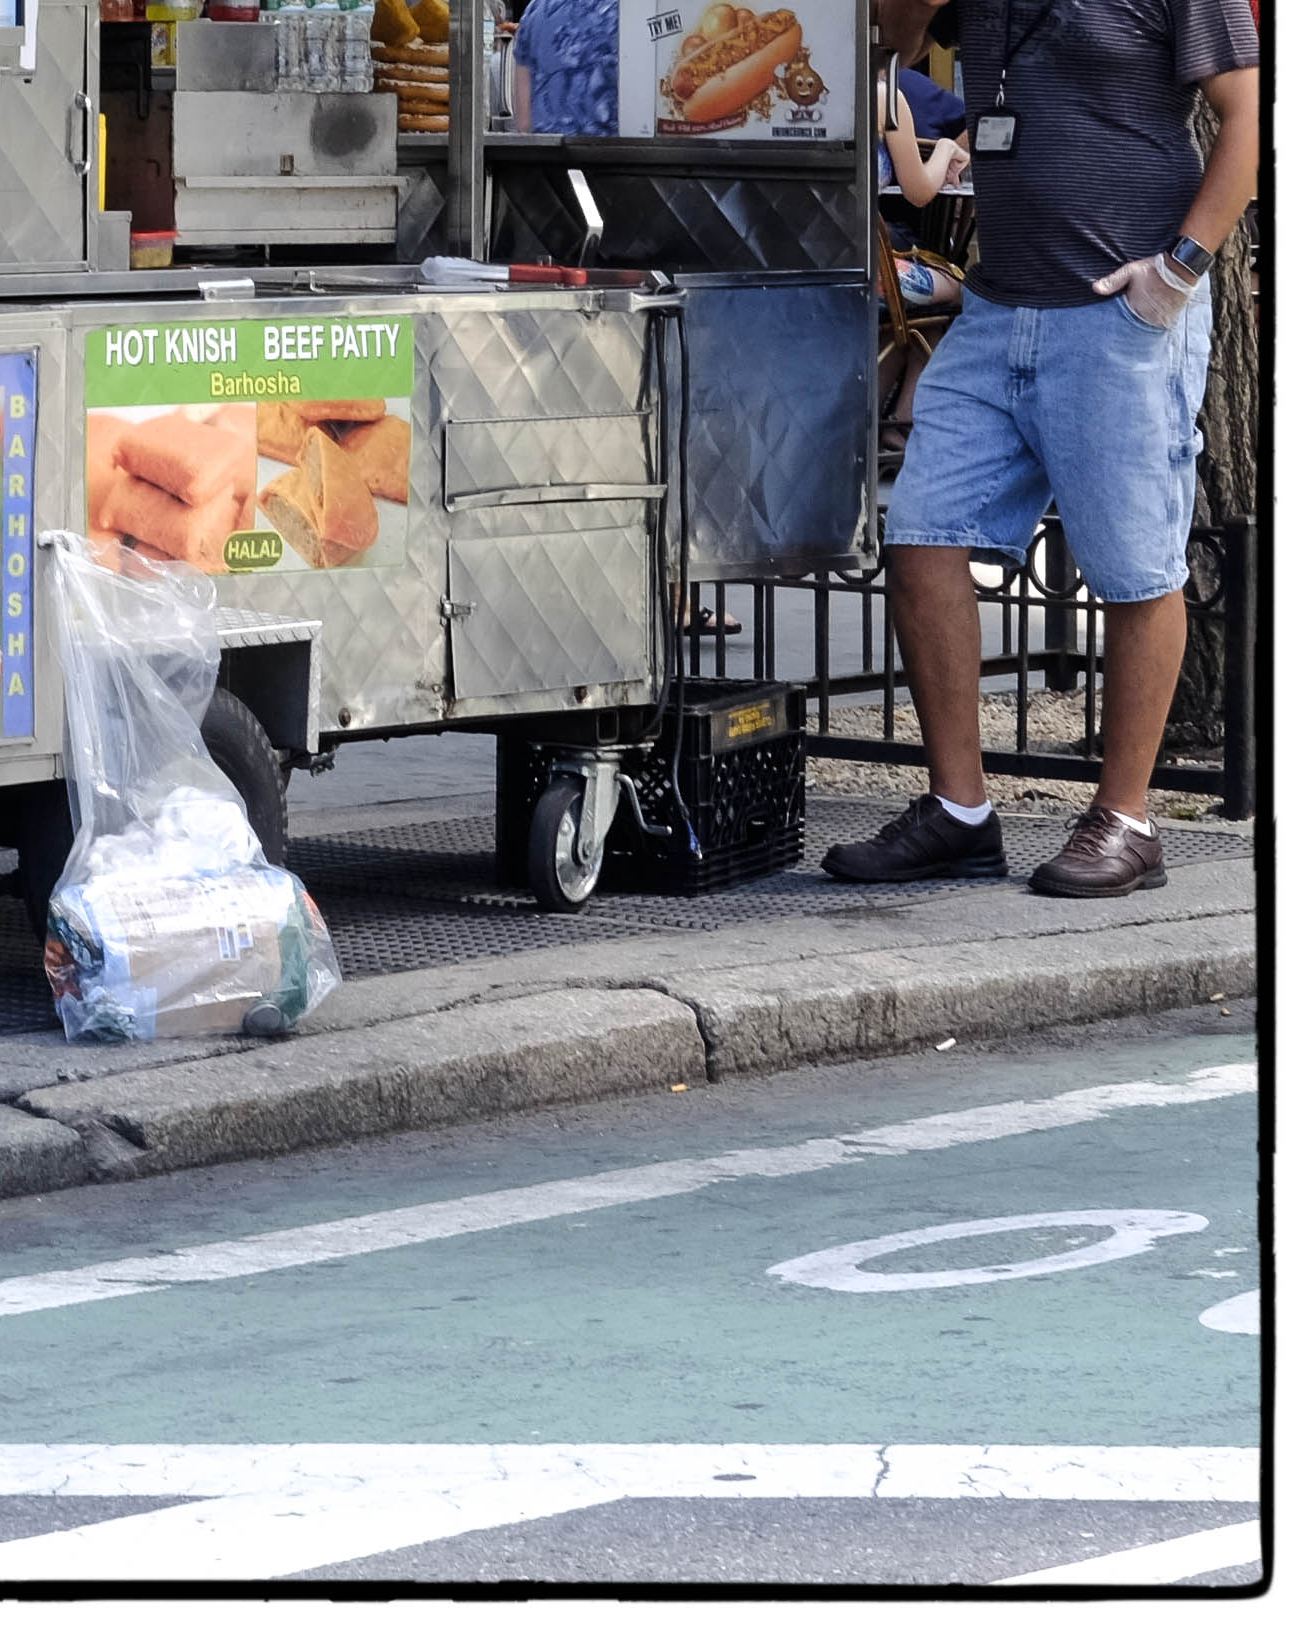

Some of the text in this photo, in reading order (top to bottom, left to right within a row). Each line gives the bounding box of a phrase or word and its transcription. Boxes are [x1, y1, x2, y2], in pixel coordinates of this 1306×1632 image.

[646, 13, 683, 38] TRY ME!
[105, 323, 401, 367] HOT KNISH BEEF PATTY
[210, 370, 302, 398] Barhosha
[7, 394, 27, 697] BARHOSHA
[227, 543, 281, 562] HALAL
